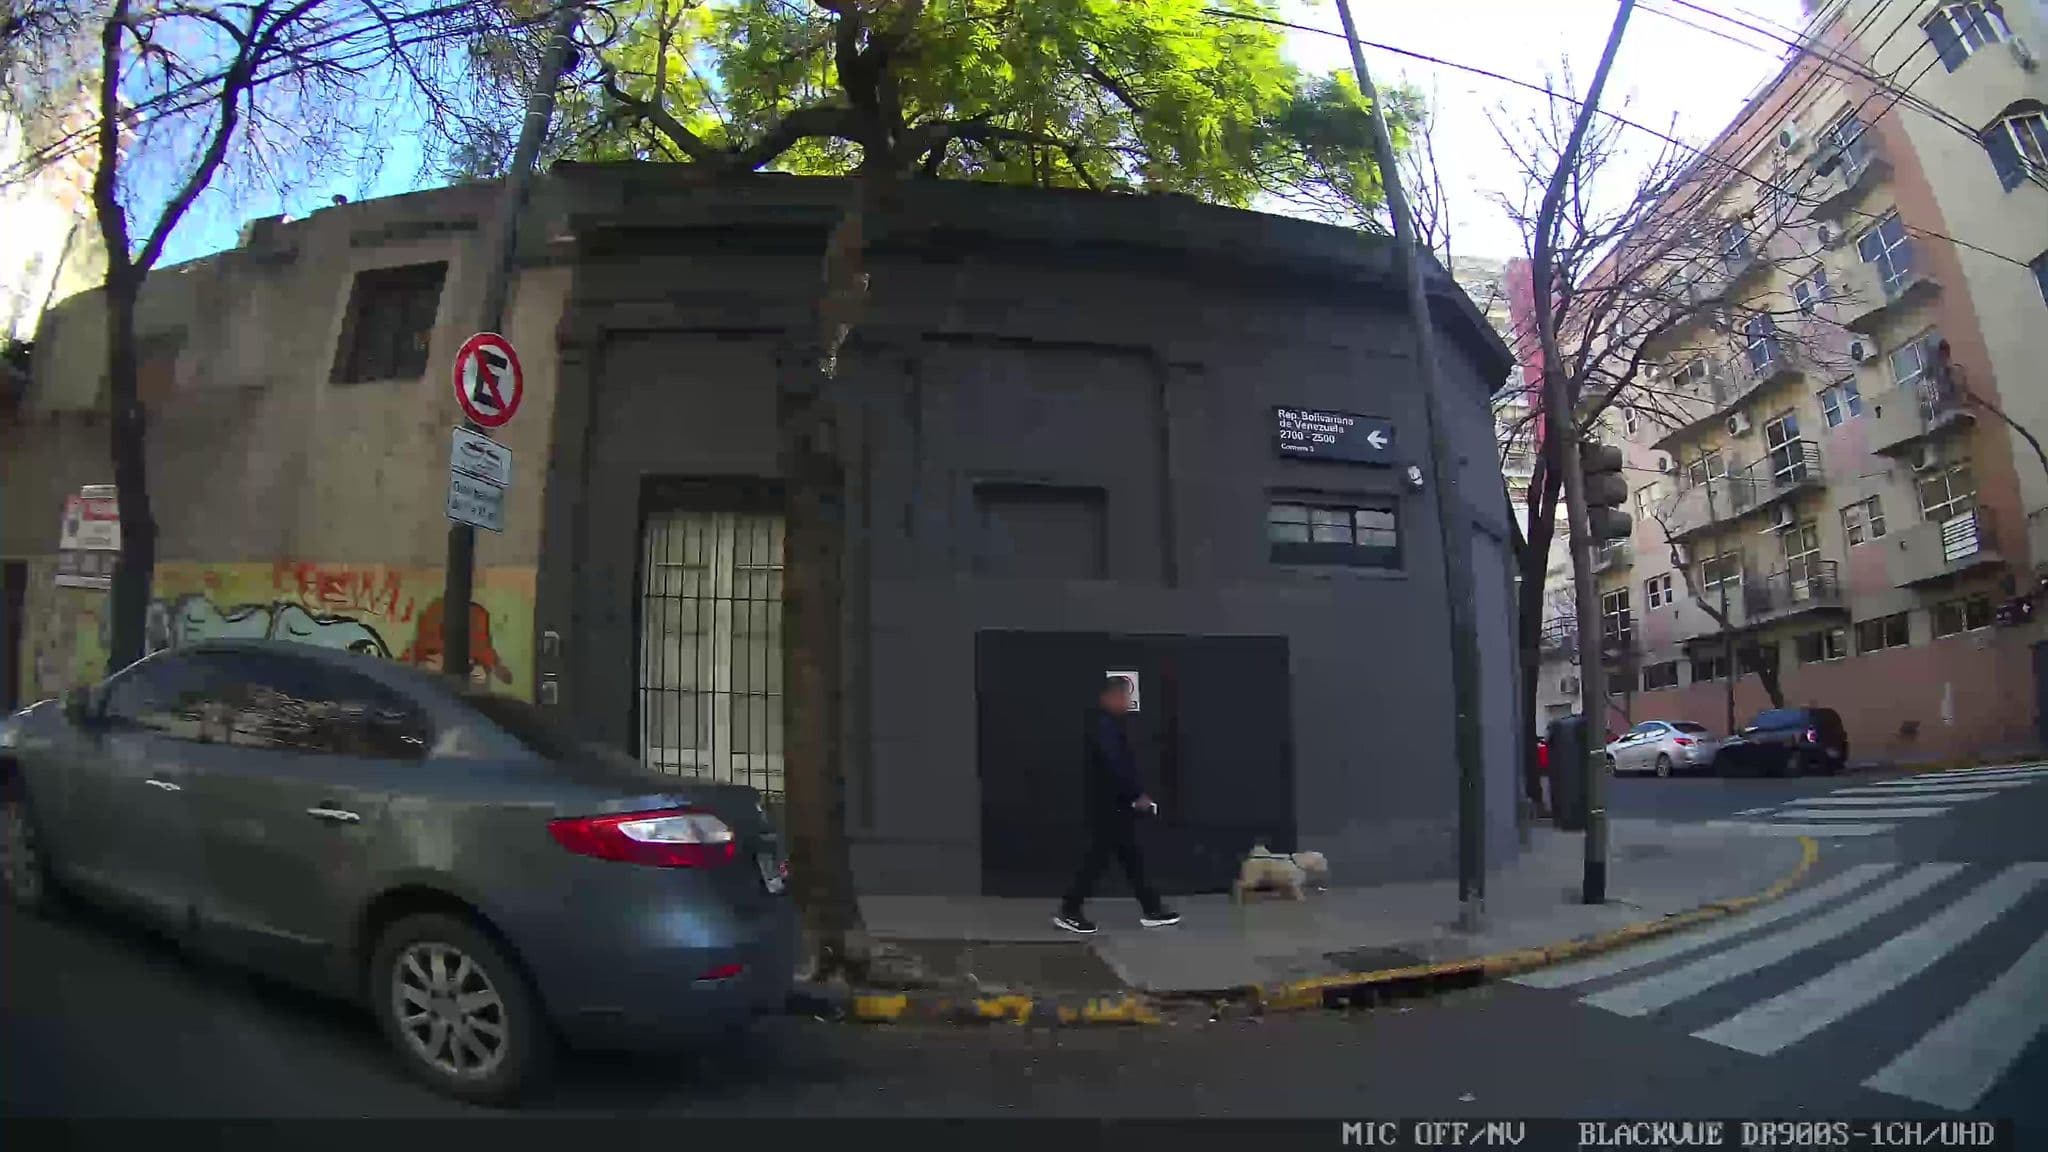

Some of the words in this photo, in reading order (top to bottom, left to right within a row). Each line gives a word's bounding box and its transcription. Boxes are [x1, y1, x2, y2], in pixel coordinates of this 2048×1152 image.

[1278, 409, 1300, 420] Rep.
[1301, 411, 1354, 426] Bolivariana
[1280, 420, 1292, 428] de
[1295, 420, 1344, 434] Venezuela
[1280, 430, 1304, 441] 2700
[1312, 433, 1336, 443] 2500
